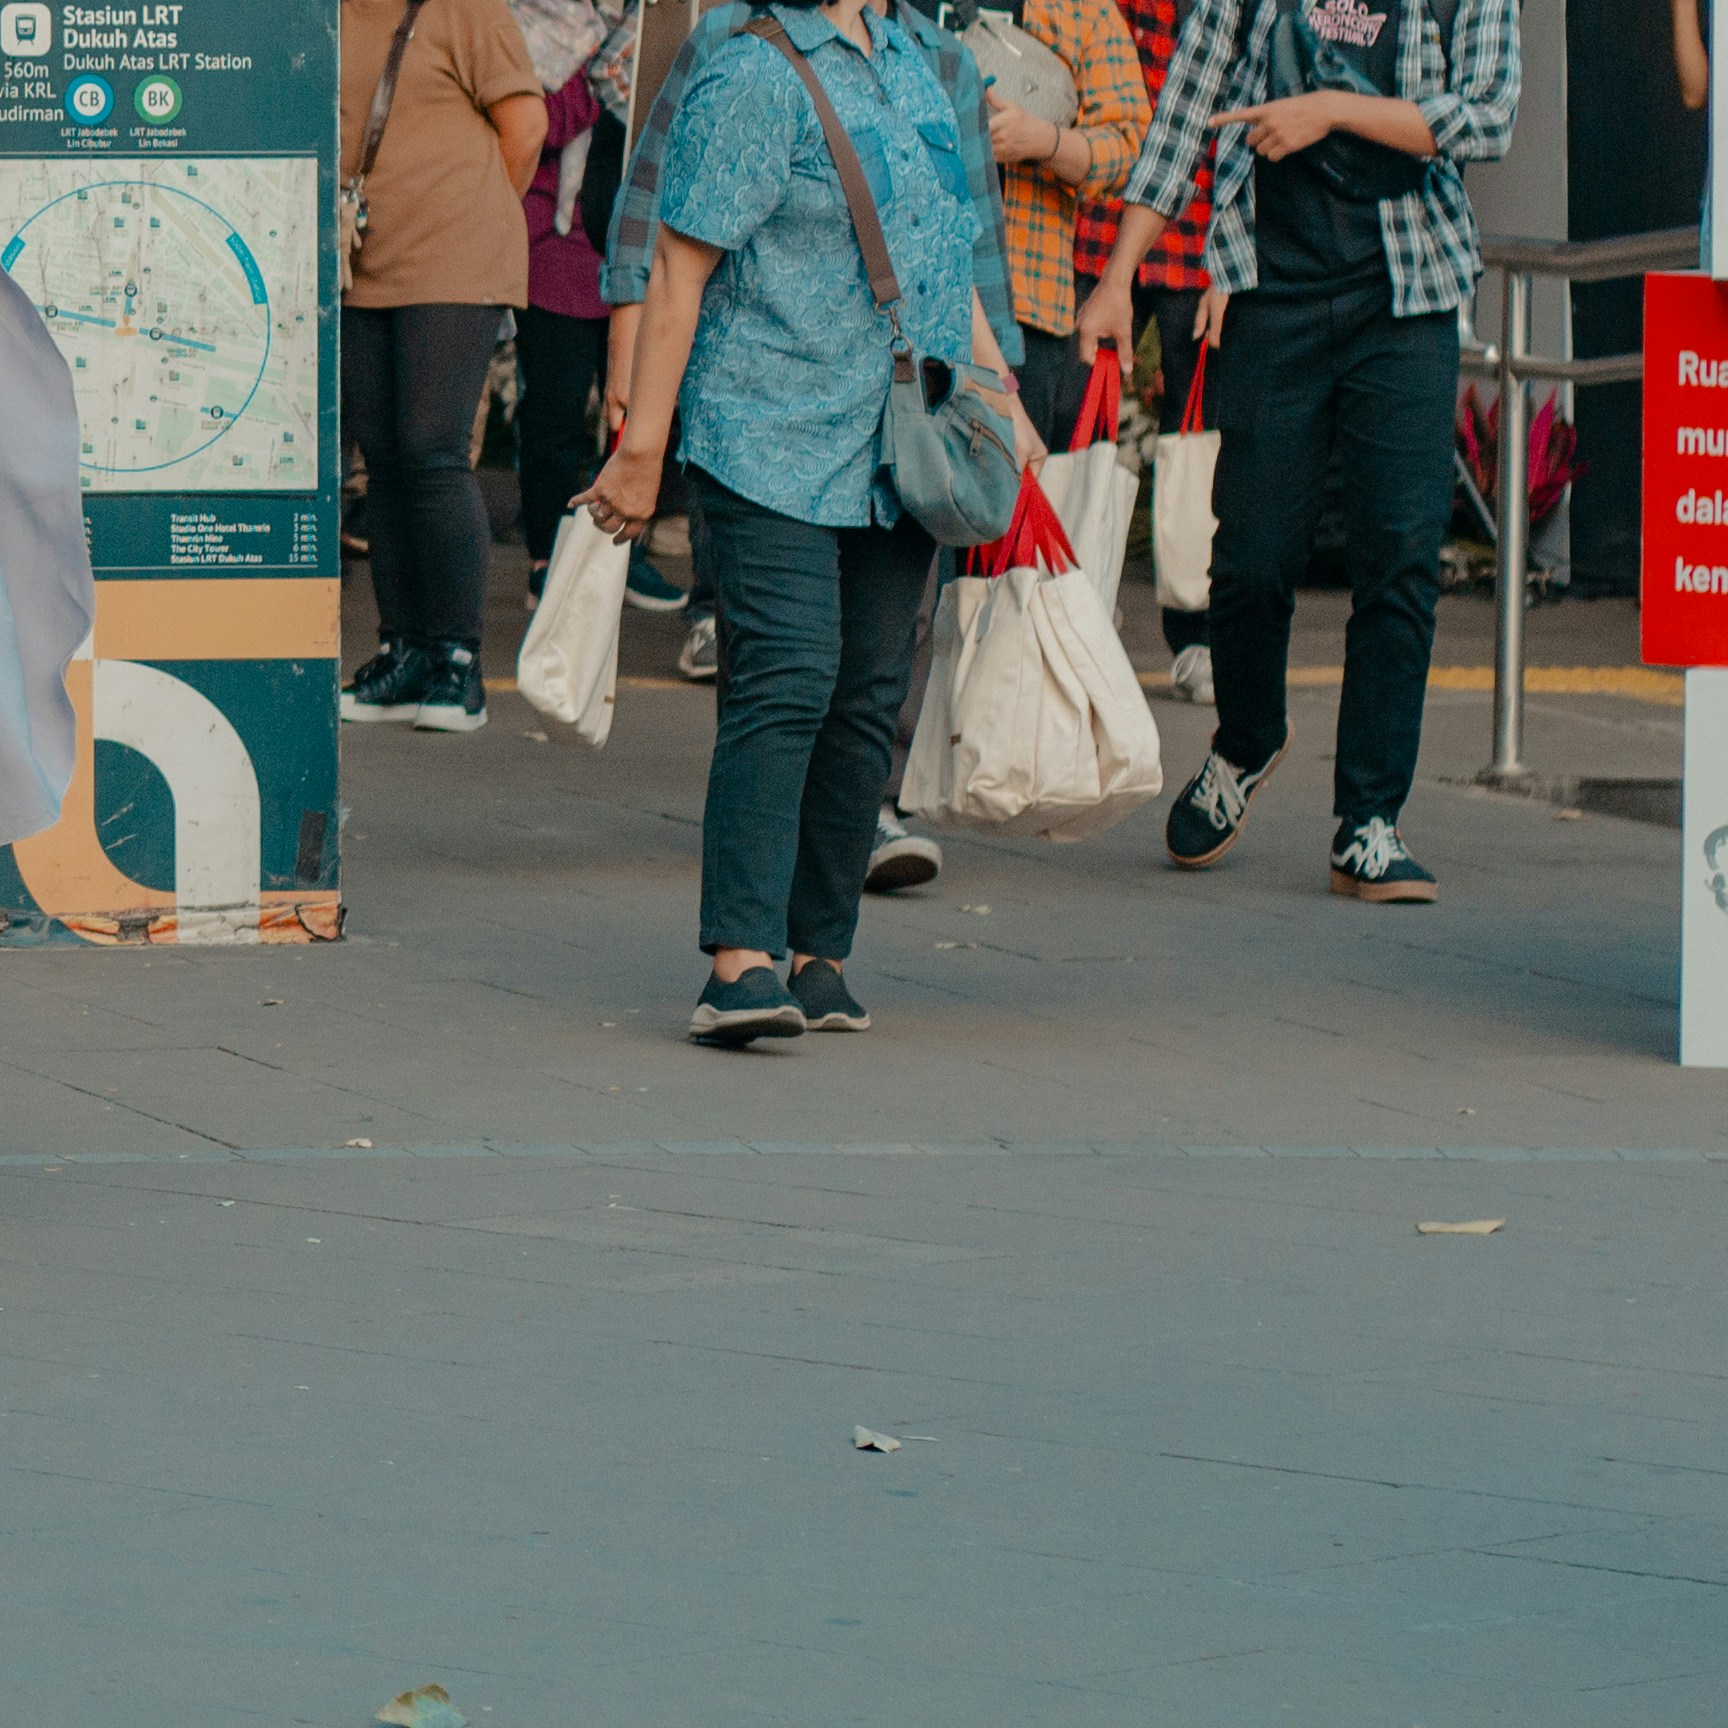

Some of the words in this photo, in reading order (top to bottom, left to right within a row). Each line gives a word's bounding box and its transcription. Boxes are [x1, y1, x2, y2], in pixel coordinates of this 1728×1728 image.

[63, 5, 137, 26] Stasiun
[143, 5, 183, 25] LRT
[63, 28, 127, 49] Dukuh
[133, 29, 178, 49] Atas
[1320, 27, 1366, 47] FESTIVAL
[64, 53, 115, 70] Dukuh
[119, 53, 154, 70] Atas
[159, 53, 191, 69] LRT
[195, 53, 252, 70] Station
[4, 62, 49, 78] 560m
[24, 82, 56, 98] KRL
[79, 91, 100, 106] CB
[148, 91, 170, 106] BK
[61, 128, 77, 136] LRT
[77, 128, 118, 137] Jabodebek
[130, 128, 145, 136] LRT
[146, 128, 187, 137] Jabodebek
[67, 139, 80, 148] Lin
[81, 139, 112, 148] Cibubur
[138, 139, 151, 148] Lin
[152, 139, 178, 148] Bekasi
